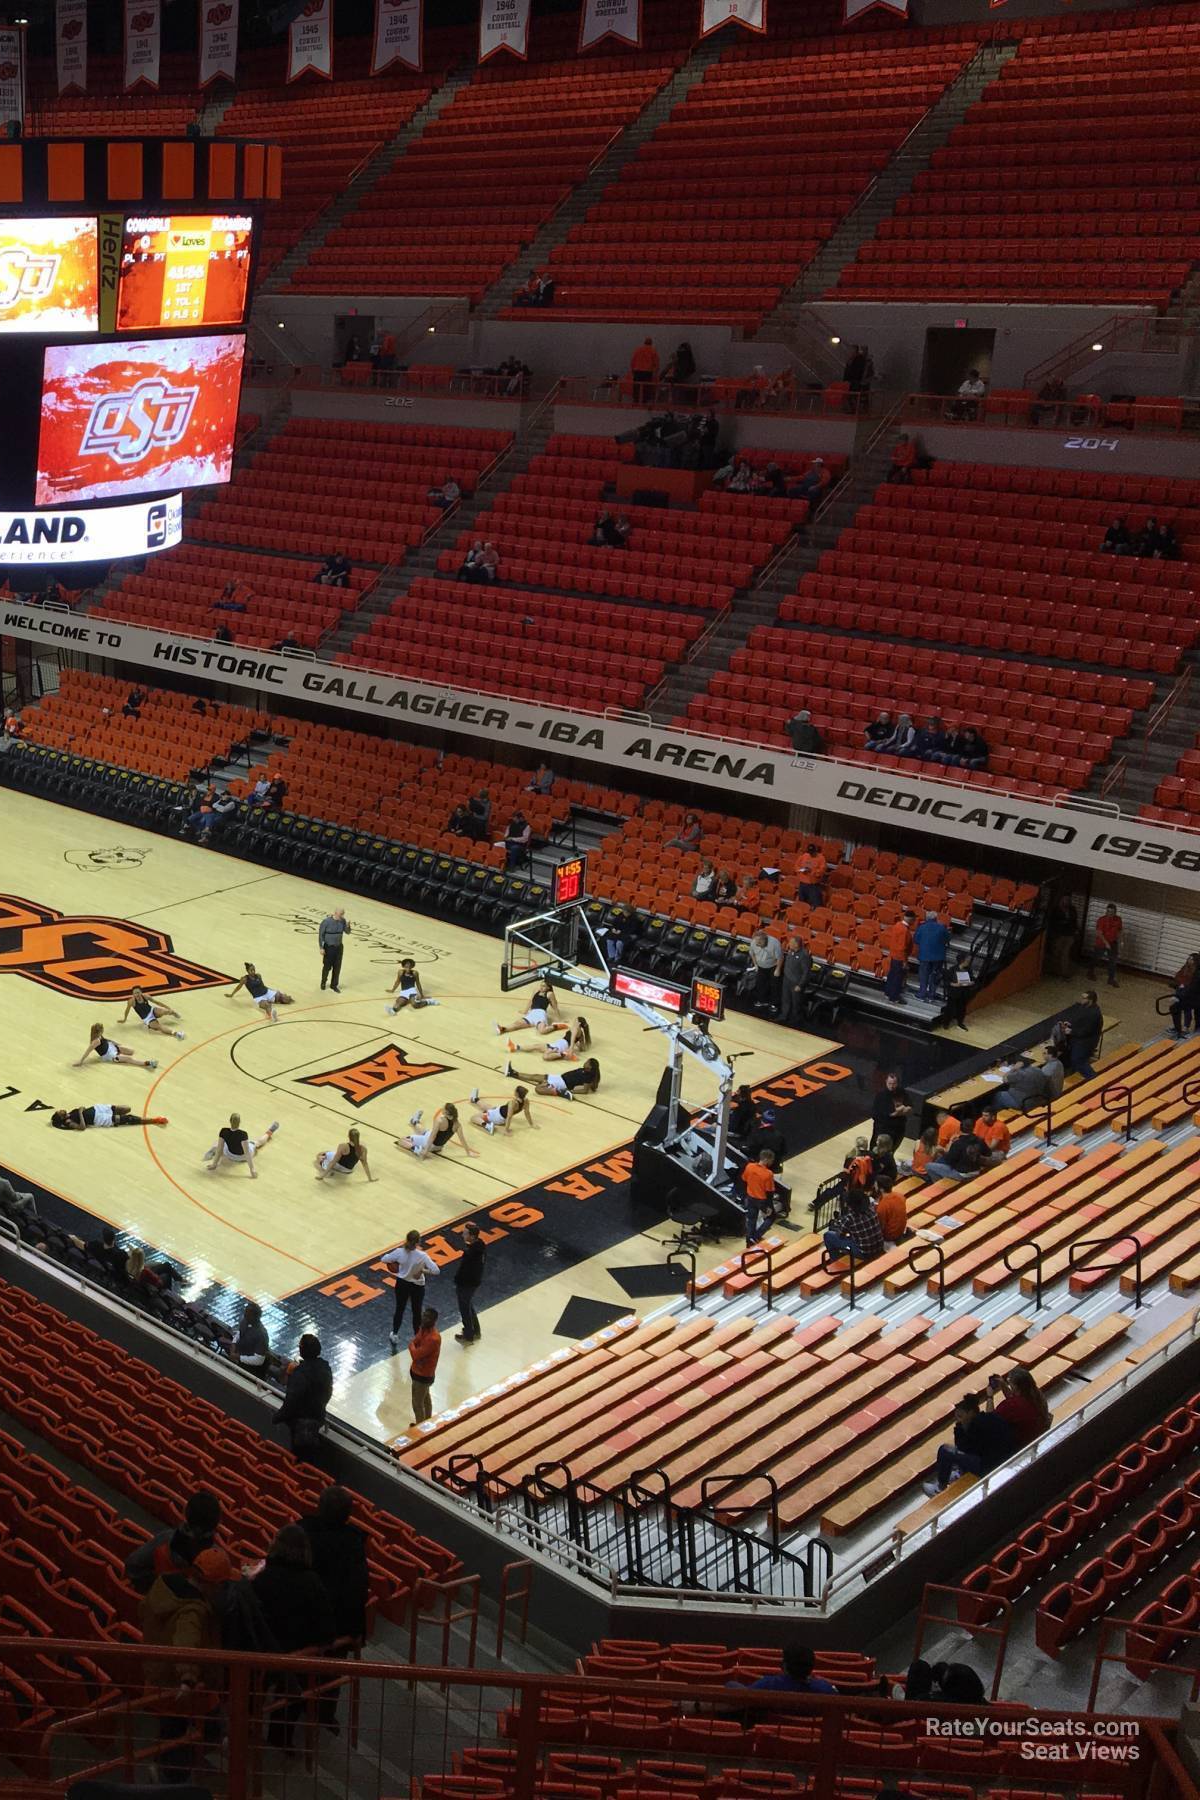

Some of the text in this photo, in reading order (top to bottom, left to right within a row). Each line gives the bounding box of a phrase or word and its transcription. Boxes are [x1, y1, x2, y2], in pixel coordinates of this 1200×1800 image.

[728, 4, 736, 13] 18
[491, 12, 517, 21] COWBOY
[487, 20, 520, 30] BASKETBALL
[126, 217, 170, 233] COWGIRLS
[102, 219, 121, 290] Hertz
[124, 252, 166, 263] PL F PT
[209, 249, 248, 260] PL F PT
[175, 297, 191, 306] TOL
[173, 309, 189, 319] FLS
[385, 396, 414, 408] 202
[79, 376, 200, 465] OSU
[1063, 436, 1121, 452] 204
[3, 612, 1200, 873] WELCOME TO HISTORIC GALLAGHER-IBA ARENA DEDICATED 1938
[560, 875, 578, 900] 30
[698, 995, 716, 1012] 30
